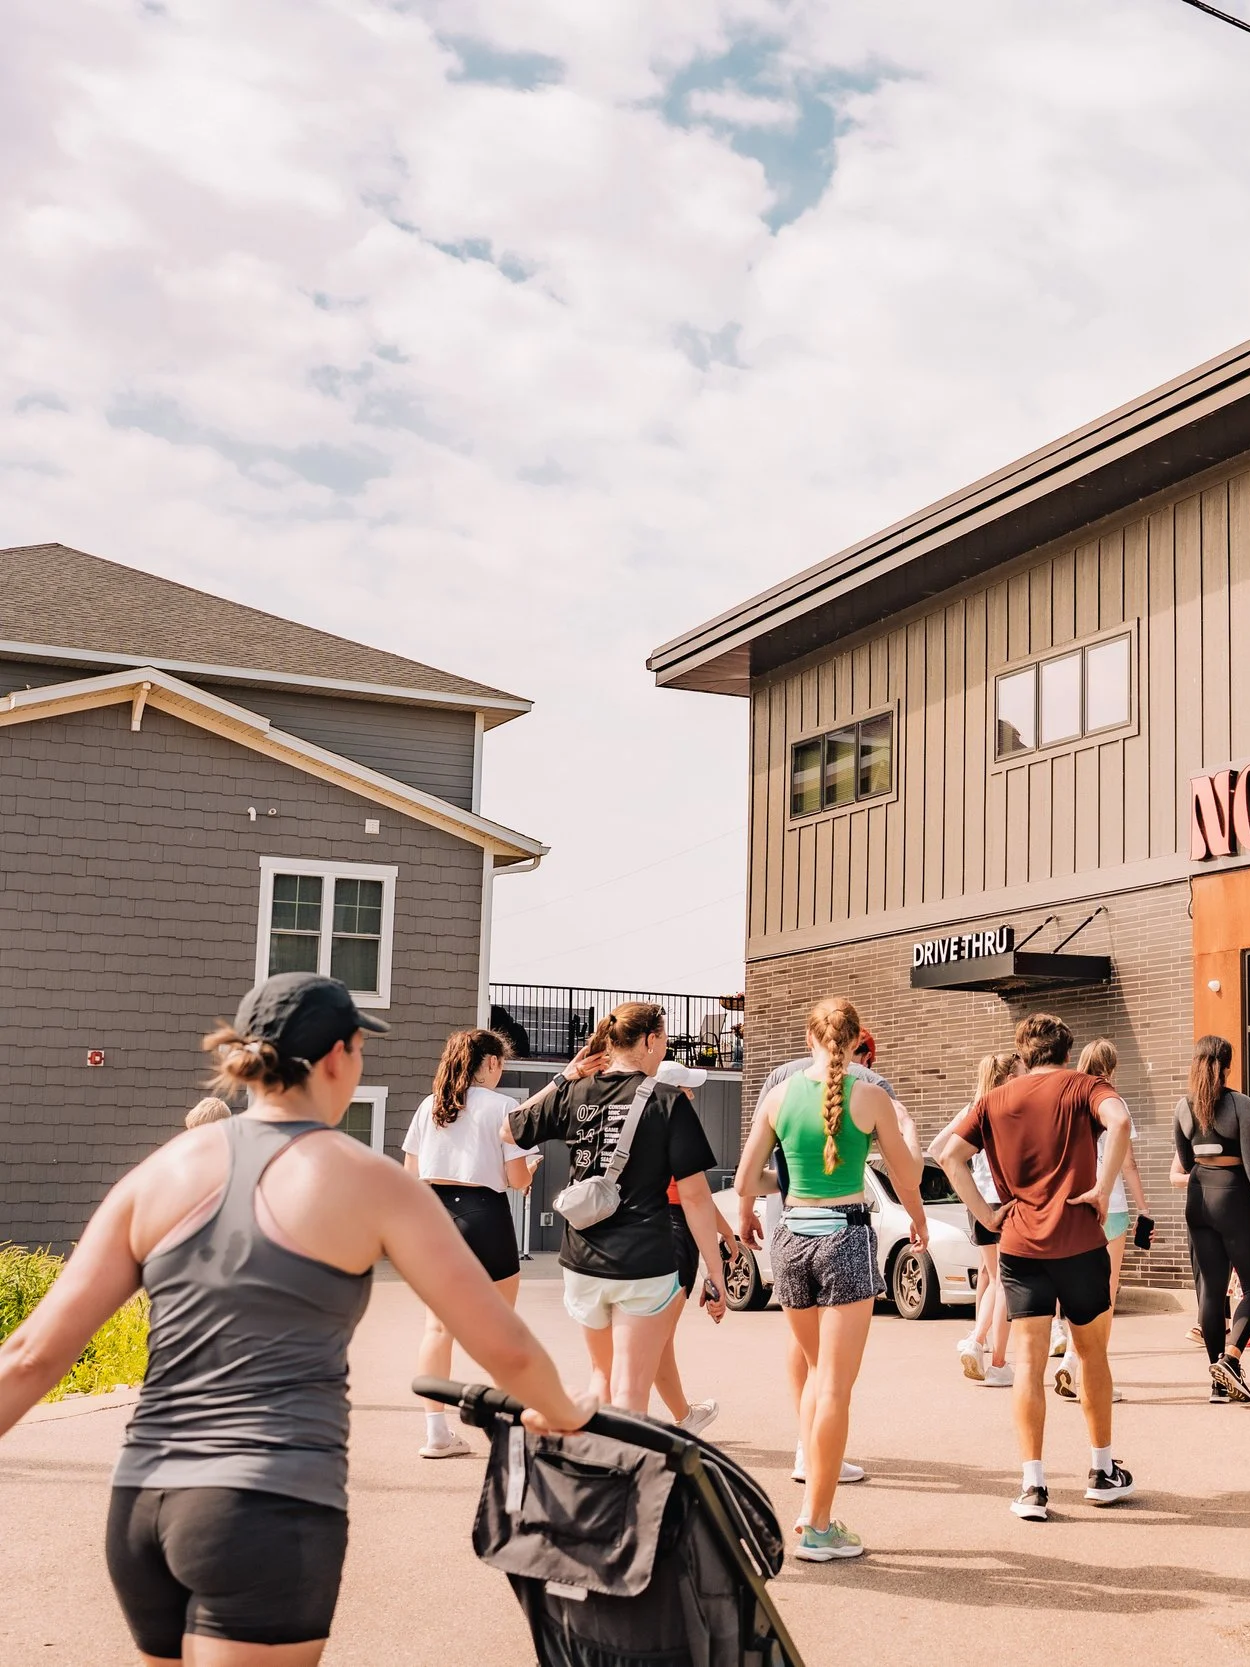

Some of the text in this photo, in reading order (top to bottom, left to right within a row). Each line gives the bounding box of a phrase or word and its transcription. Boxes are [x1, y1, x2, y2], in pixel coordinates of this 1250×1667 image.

[913, 927, 1009, 967] DRIVE THRU
[576, 1104, 599, 1122] 07
[576, 1129, 595, 1143] 14
[576, 1149, 591, 1167] 23
